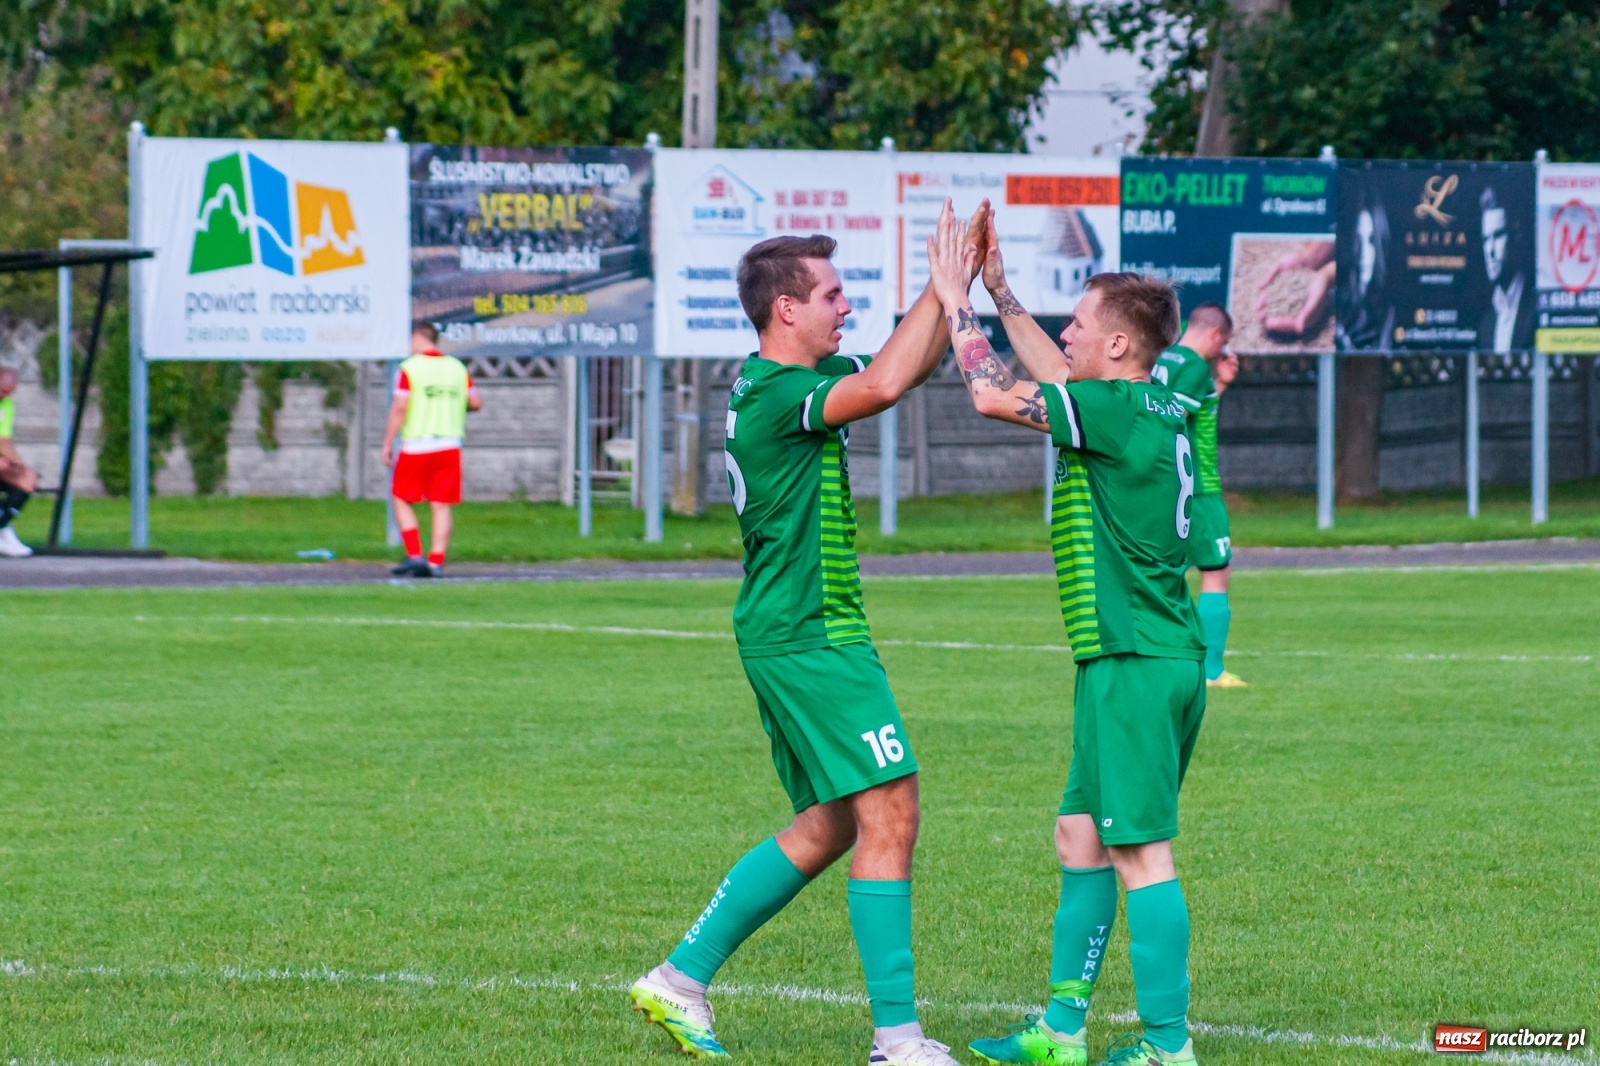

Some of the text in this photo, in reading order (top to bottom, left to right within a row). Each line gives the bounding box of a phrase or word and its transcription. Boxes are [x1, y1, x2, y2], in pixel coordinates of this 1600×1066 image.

[1122, 172, 1248, 206] EKO-PELLET
[460, 245, 600, 272] Marek Zawadzki
[186, 285, 370, 321] powiat raciborski
[580, 321, 618, 348] Maja
[1175, 432, 1195, 540] 8
[861, 723, 904, 769] 16
[1074, 925, 1107, 1008] TWORKW
